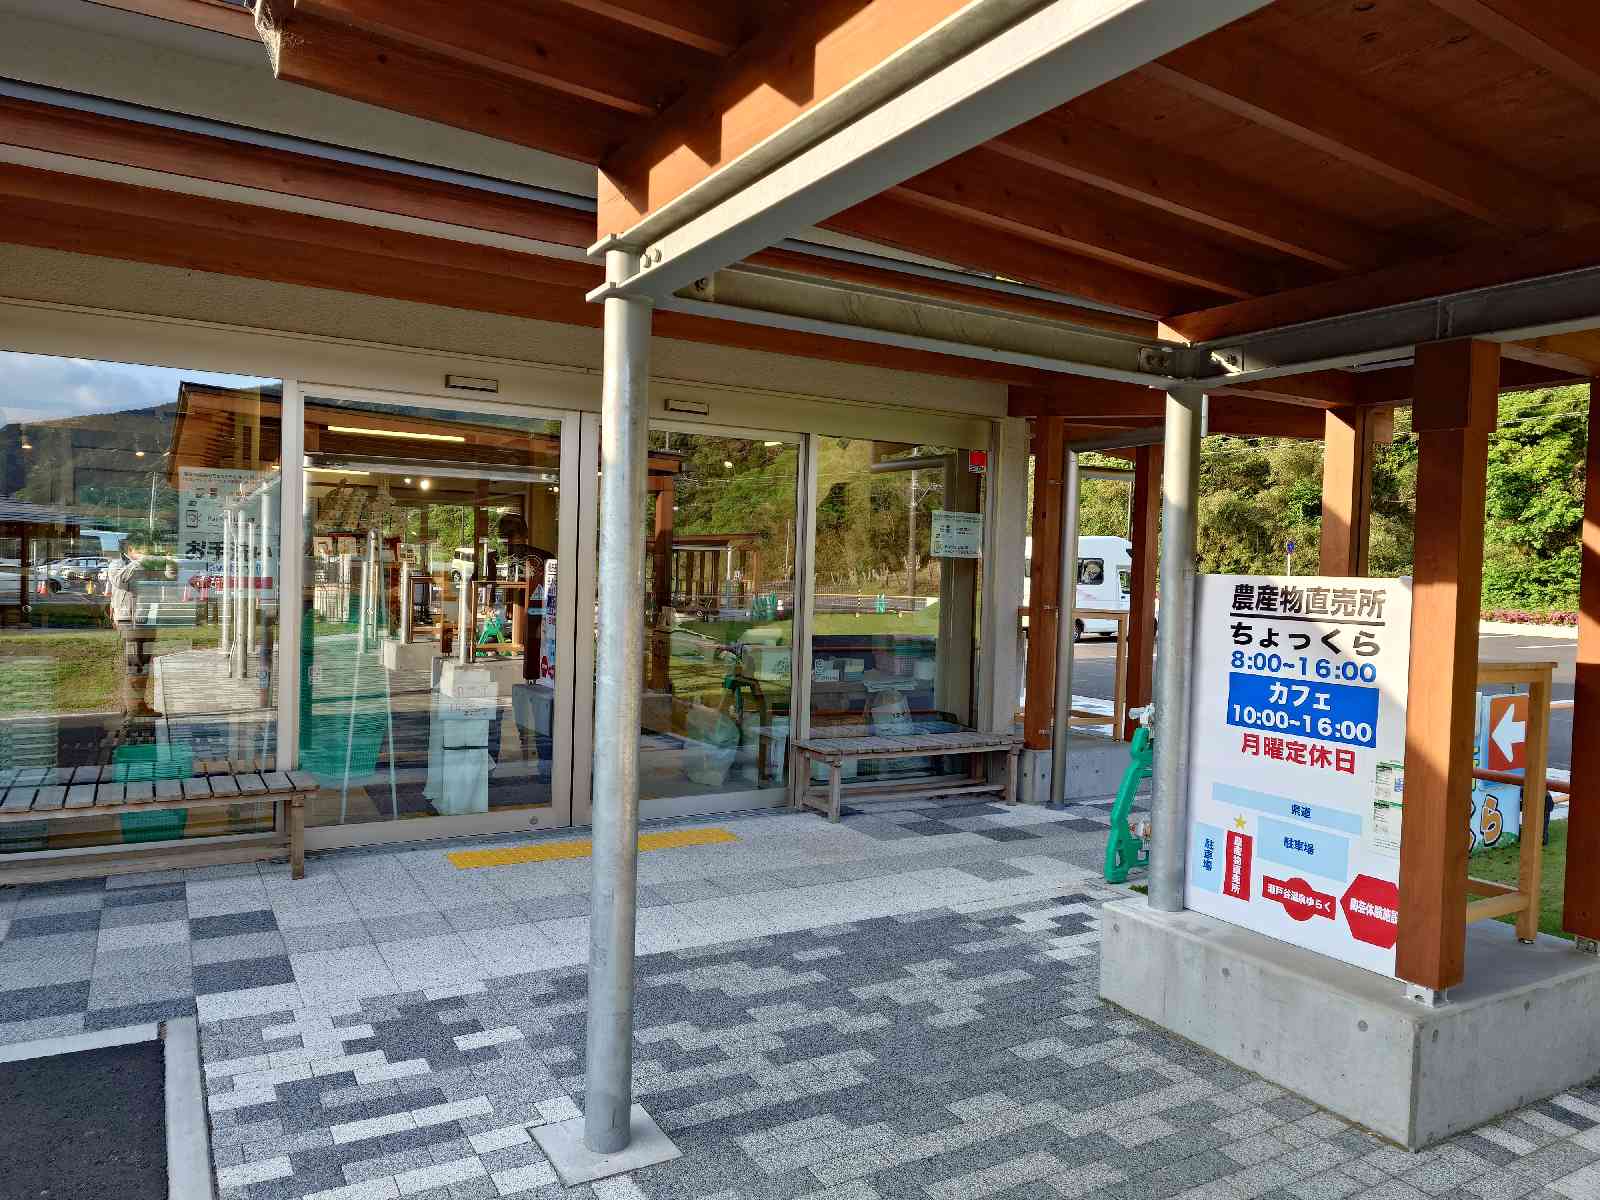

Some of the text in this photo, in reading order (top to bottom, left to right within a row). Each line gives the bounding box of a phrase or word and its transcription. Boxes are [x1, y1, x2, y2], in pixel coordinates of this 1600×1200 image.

[1231, 584, 1386, 619] 農産物直売所
[1230, 621, 1381, 657] ちょっくら
[1268, 682, 1331, 711] カフェ
[1241, 732, 1356, 775] 月曜定休日
[1291, 804, 1313, 819] 県道
[1203, 838, 1215, 872] 駐車場
[1283, 836, 1315, 856] 駐車場
